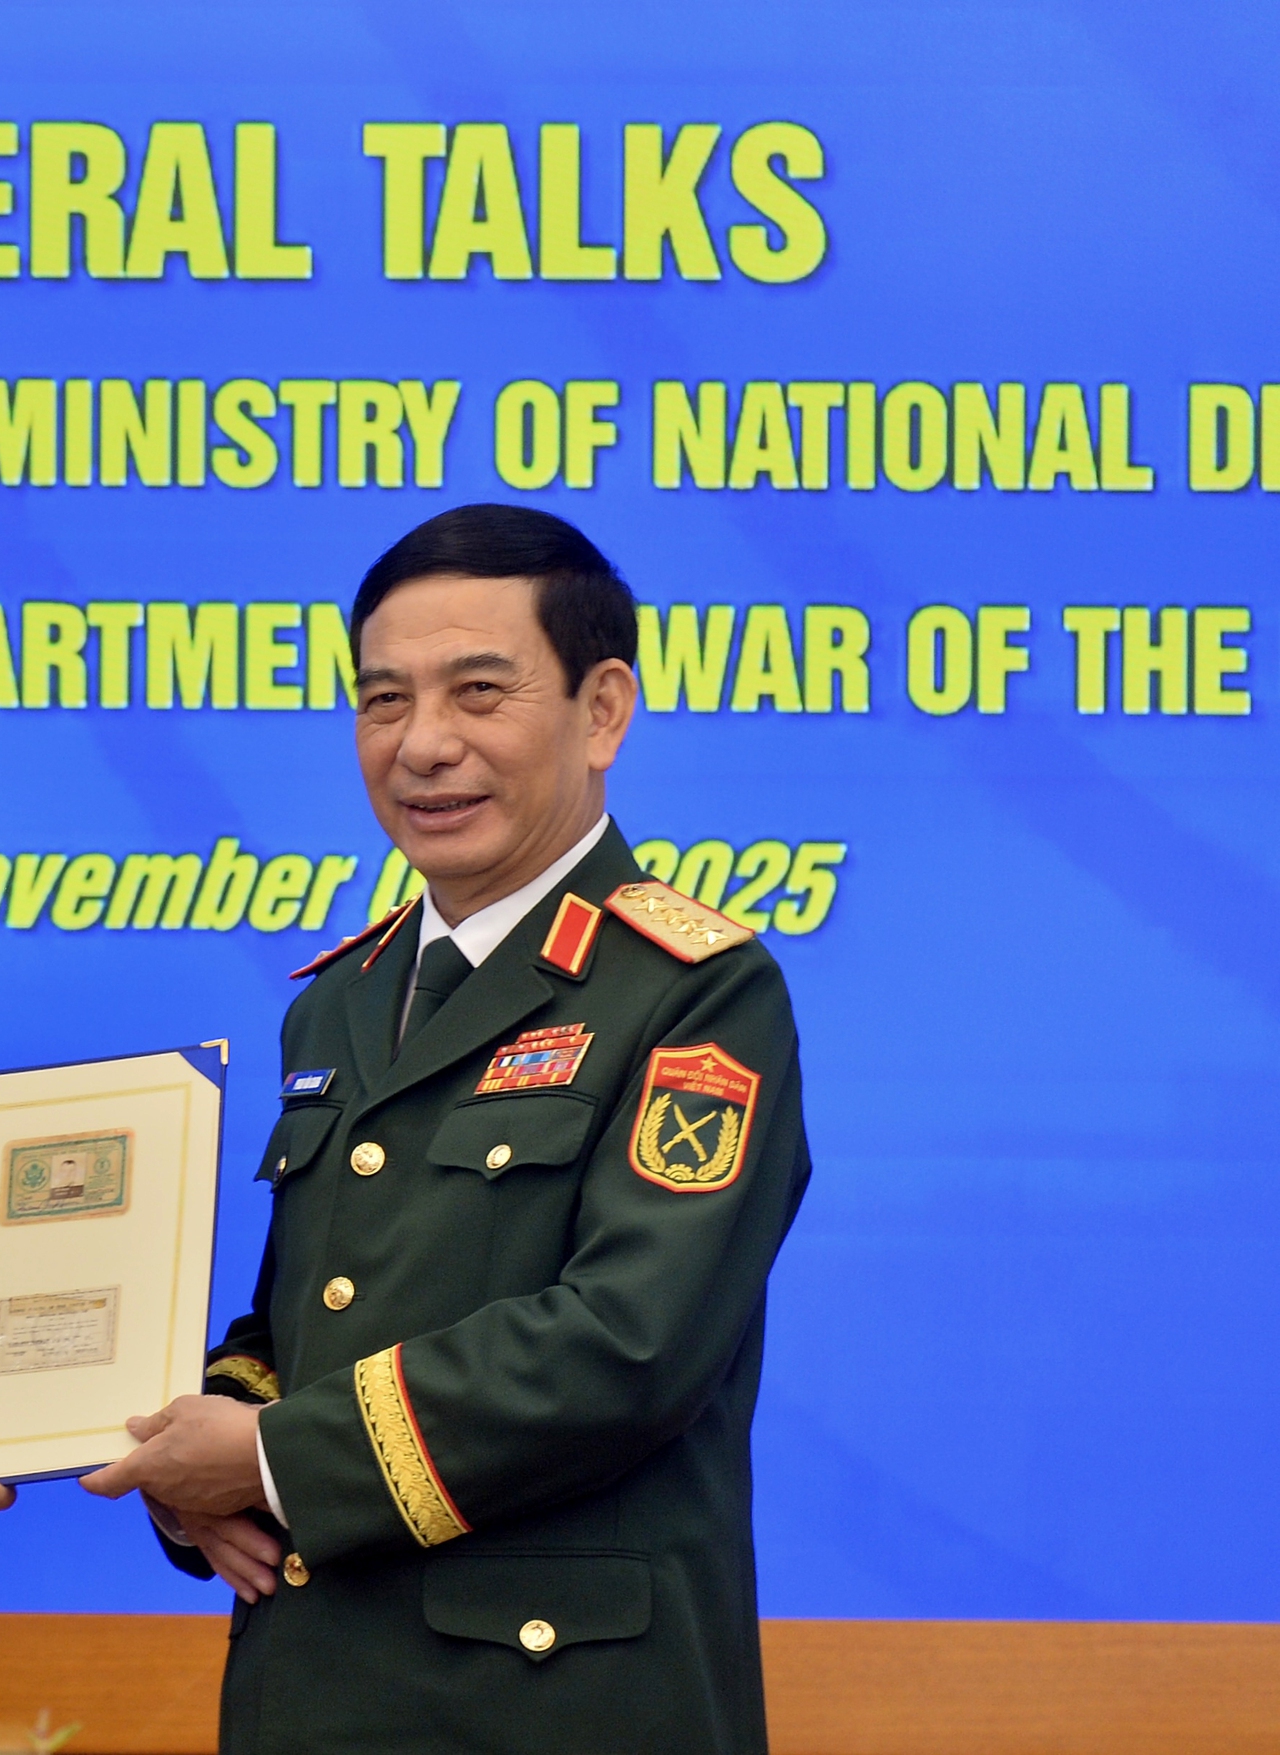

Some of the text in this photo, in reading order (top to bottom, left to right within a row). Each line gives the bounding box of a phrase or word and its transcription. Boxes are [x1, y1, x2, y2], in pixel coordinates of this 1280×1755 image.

[363, 122, 827, 281] TALKS
[494, 380, 619, 490] OF
[653, 381, 1154, 491] NATIONAL
[635, 605, 870, 712] WAR
[907, 607, 1029, 714] OF
[1064, 607, 1251, 716] THE
